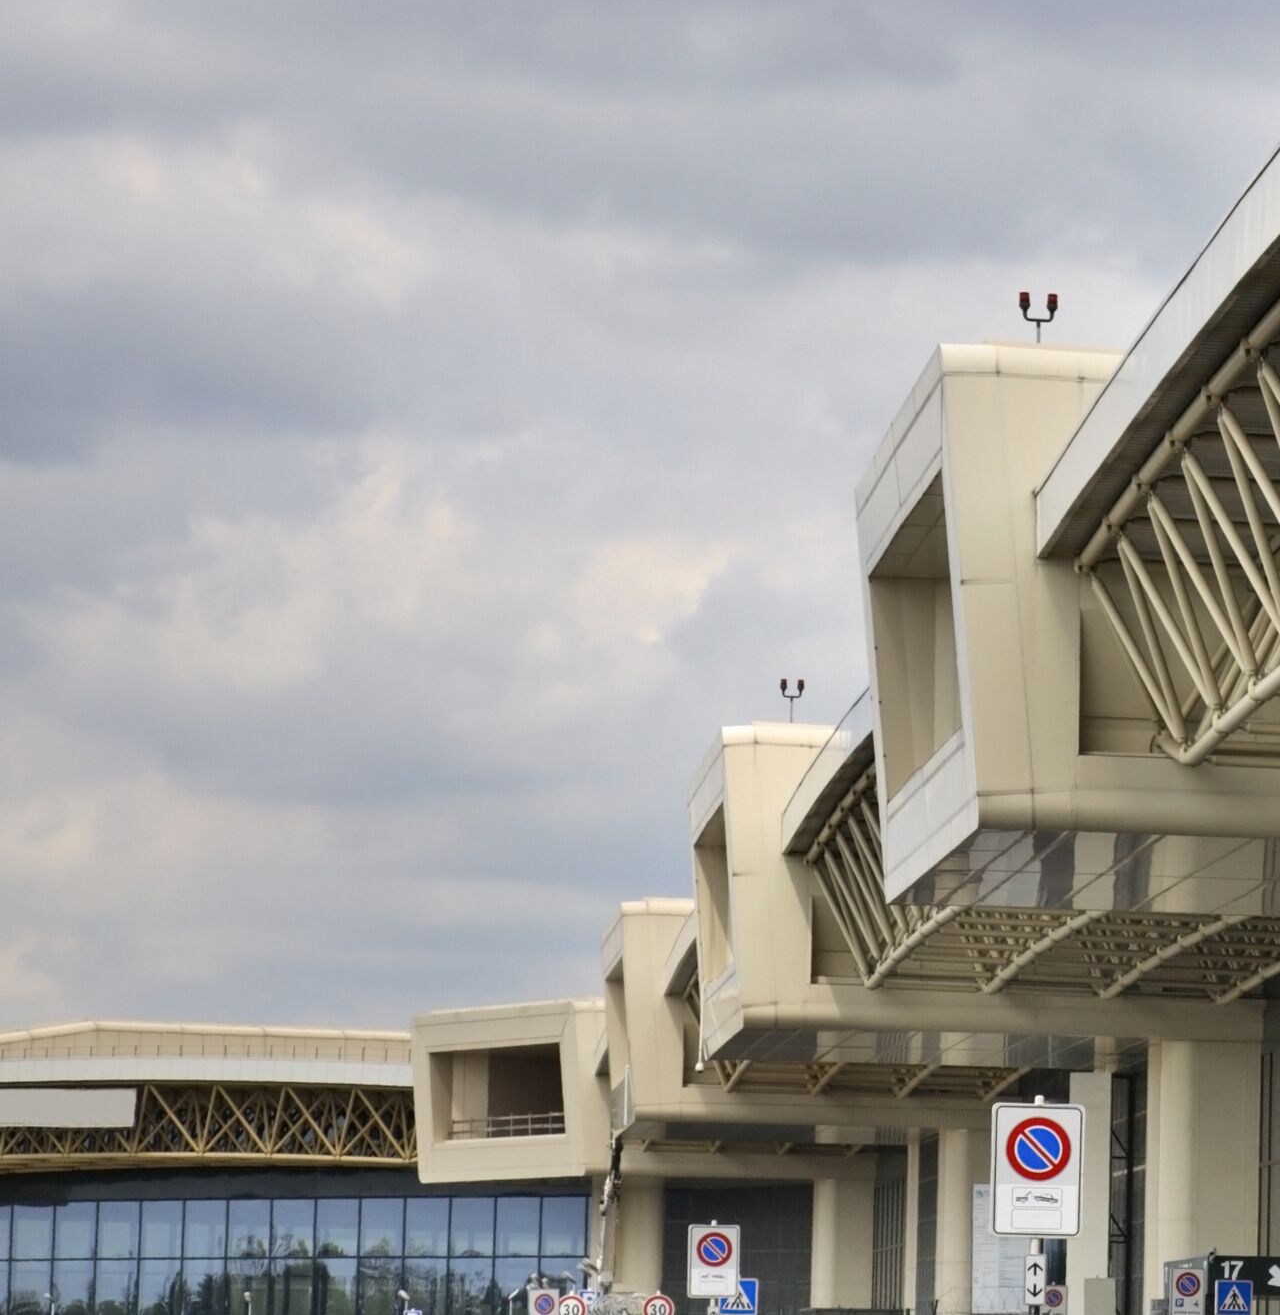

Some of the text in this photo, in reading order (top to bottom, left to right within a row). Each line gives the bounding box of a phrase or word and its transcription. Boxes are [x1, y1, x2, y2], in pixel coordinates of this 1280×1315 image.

[1221, 1260, 1244, 1280] 17
[563, 1304, 579, 1315] 30
[650, 1304, 666, 1315] 30
